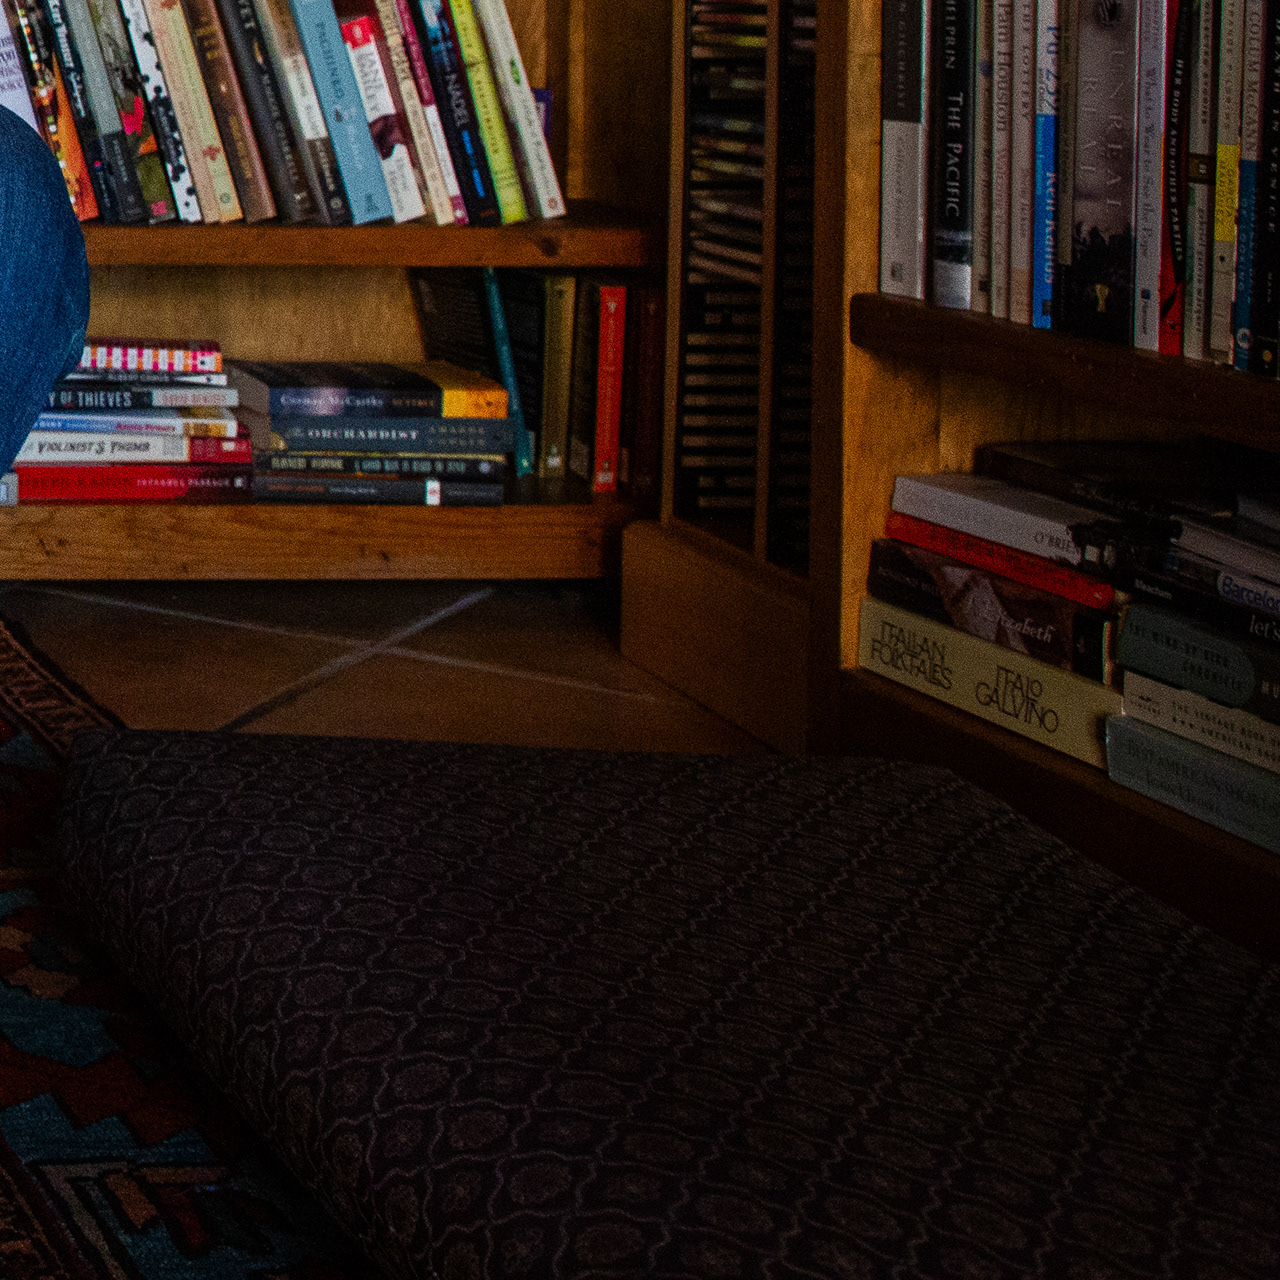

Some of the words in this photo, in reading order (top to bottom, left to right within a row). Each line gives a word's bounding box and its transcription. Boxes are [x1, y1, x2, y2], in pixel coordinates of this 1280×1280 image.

[997, 2, 1012, 46] Pam
[1247, 11, 1262, 73] COLUM
[996, 49, 1012, 132] Houston
[1021, 45, 1031, 120] LOTTERY
[946, 91, 964, 130] THE
[945, 141, 962, 218] PACIFIC
[76, 390, 133, 408] THIEVES
[307, 428, 419, 440] ORCHARDIST
